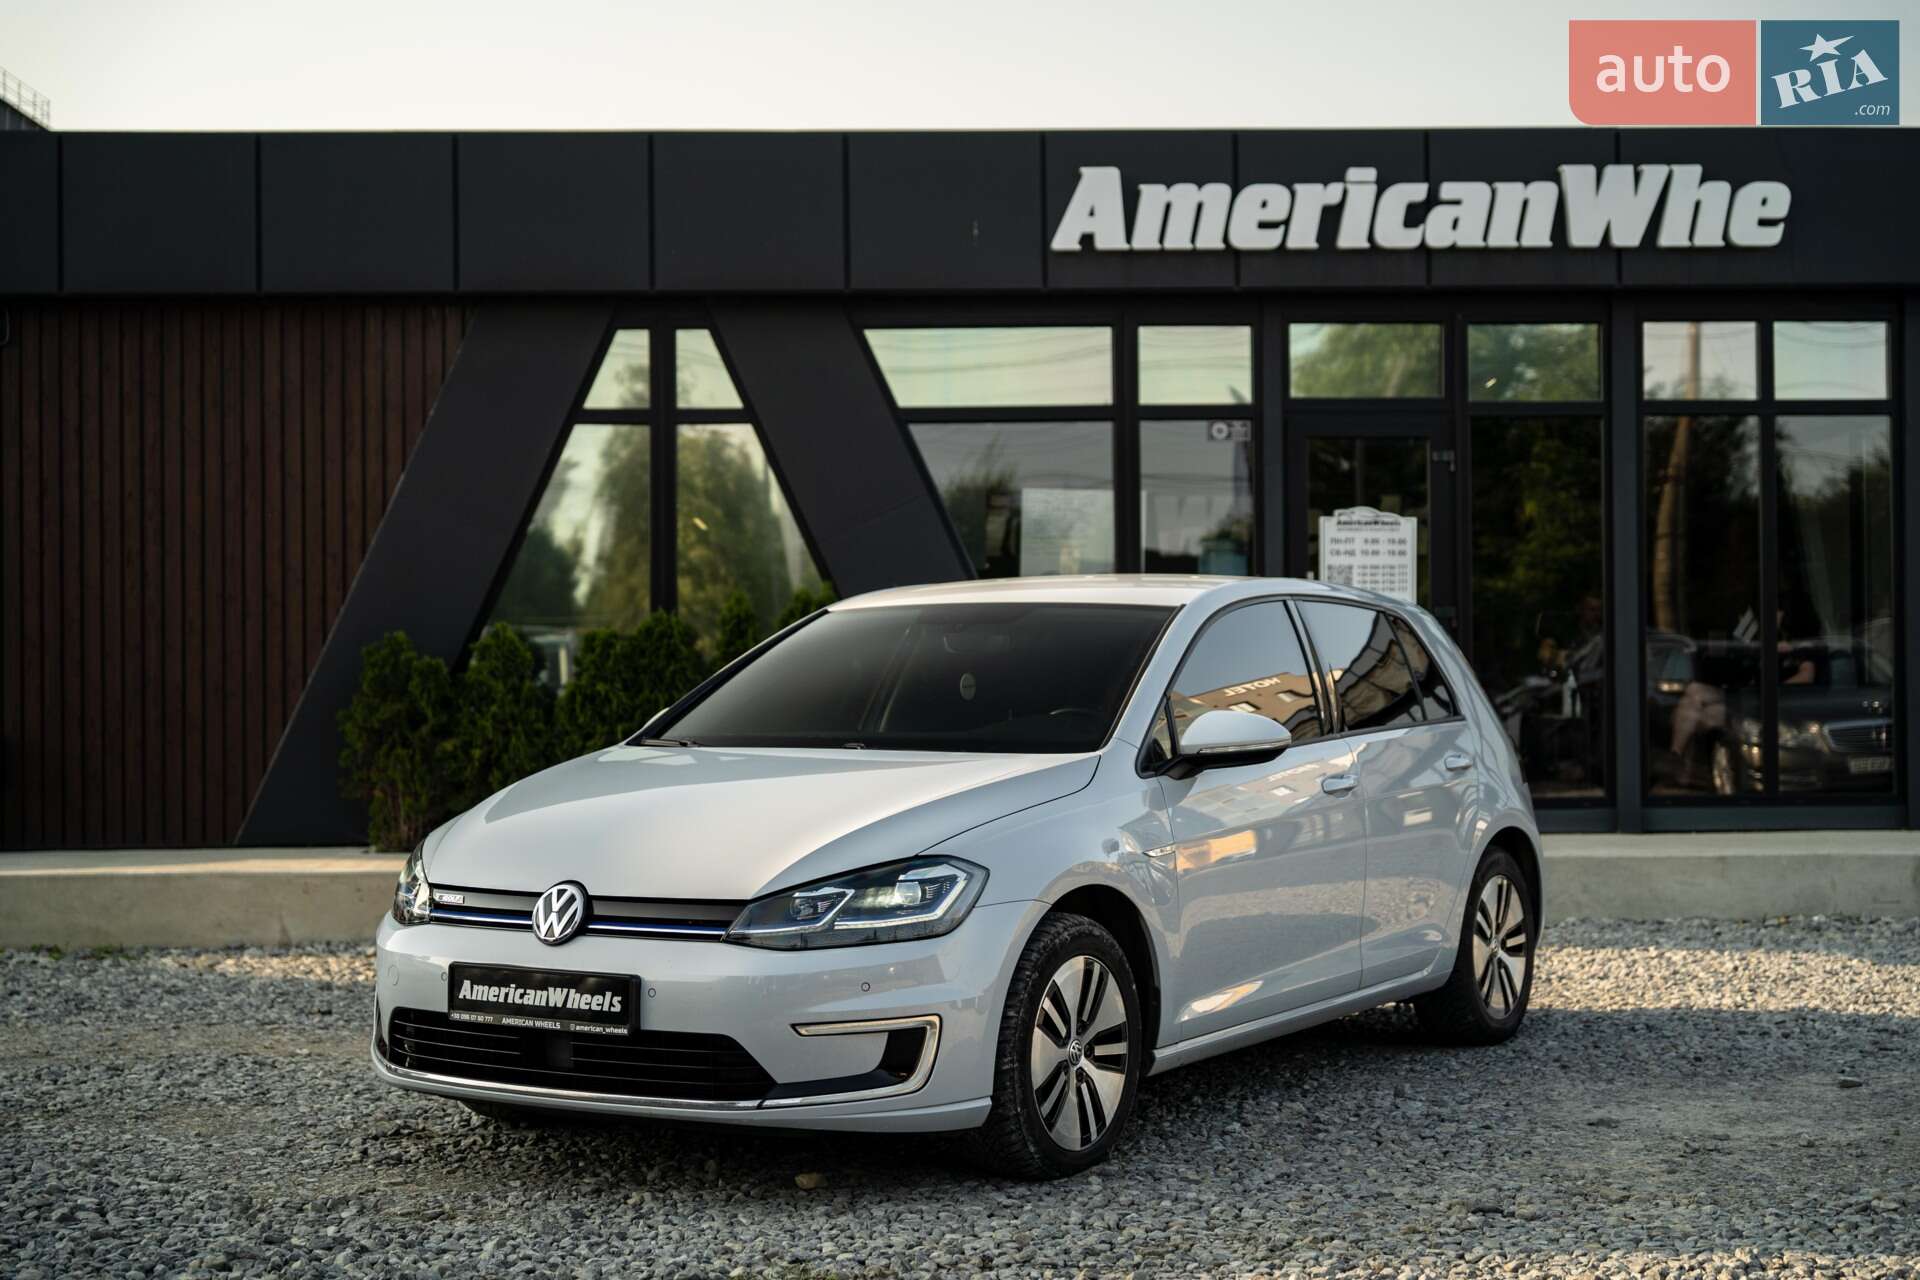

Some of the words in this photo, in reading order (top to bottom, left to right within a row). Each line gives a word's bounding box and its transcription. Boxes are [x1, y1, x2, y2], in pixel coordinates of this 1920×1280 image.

[1050, 164, 1793, 252] AmericanWhe
[458, 979, 623, 1013] AmericanWheels
[501, 1017, 534, 1027] AMERICAN
[534, 1019, 561, 1030] WHEELS
